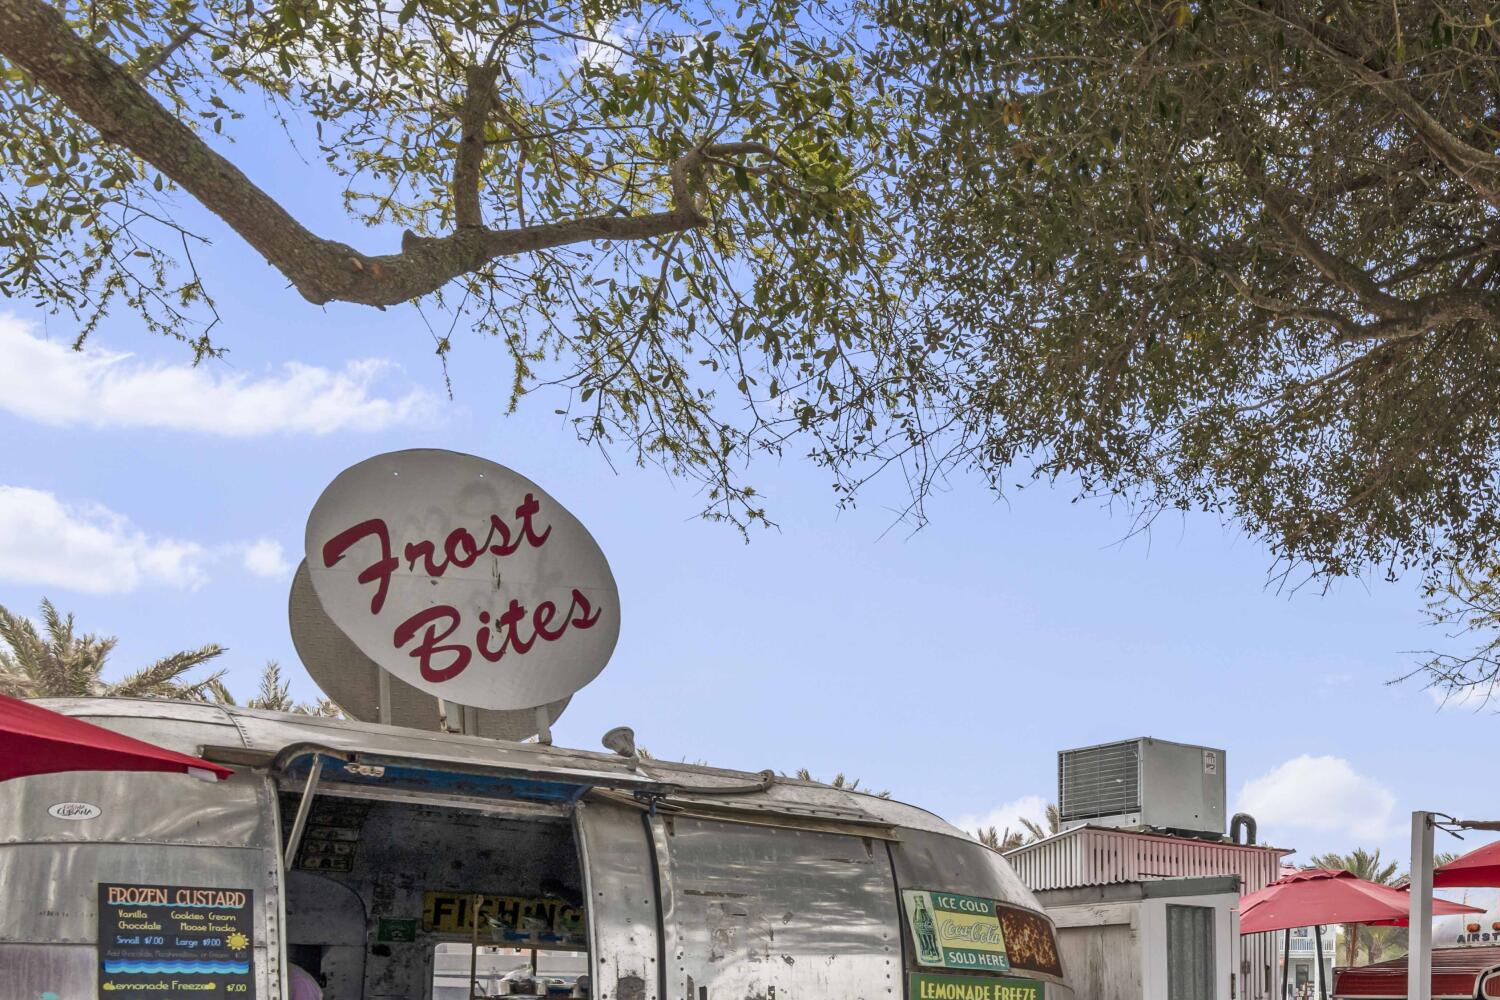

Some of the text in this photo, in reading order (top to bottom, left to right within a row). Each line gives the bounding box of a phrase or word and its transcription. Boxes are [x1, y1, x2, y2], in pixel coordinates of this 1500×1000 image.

[323, 493, 552, 615] Frost
[394, 589, 601, 683] Bites
[108, 887, 246, 907] FROZEN CUSTARD
[938, 896, 988, 913] ICE COLD
[118, 909, 147, 918] Vanilla
[118, 921, 162, 930] Chocolate
[116, 936, 164, 945] Small $7.00
[949, 952, 1005, 967] SOLD HERE
[226, 984, 247, 992] $7.00
